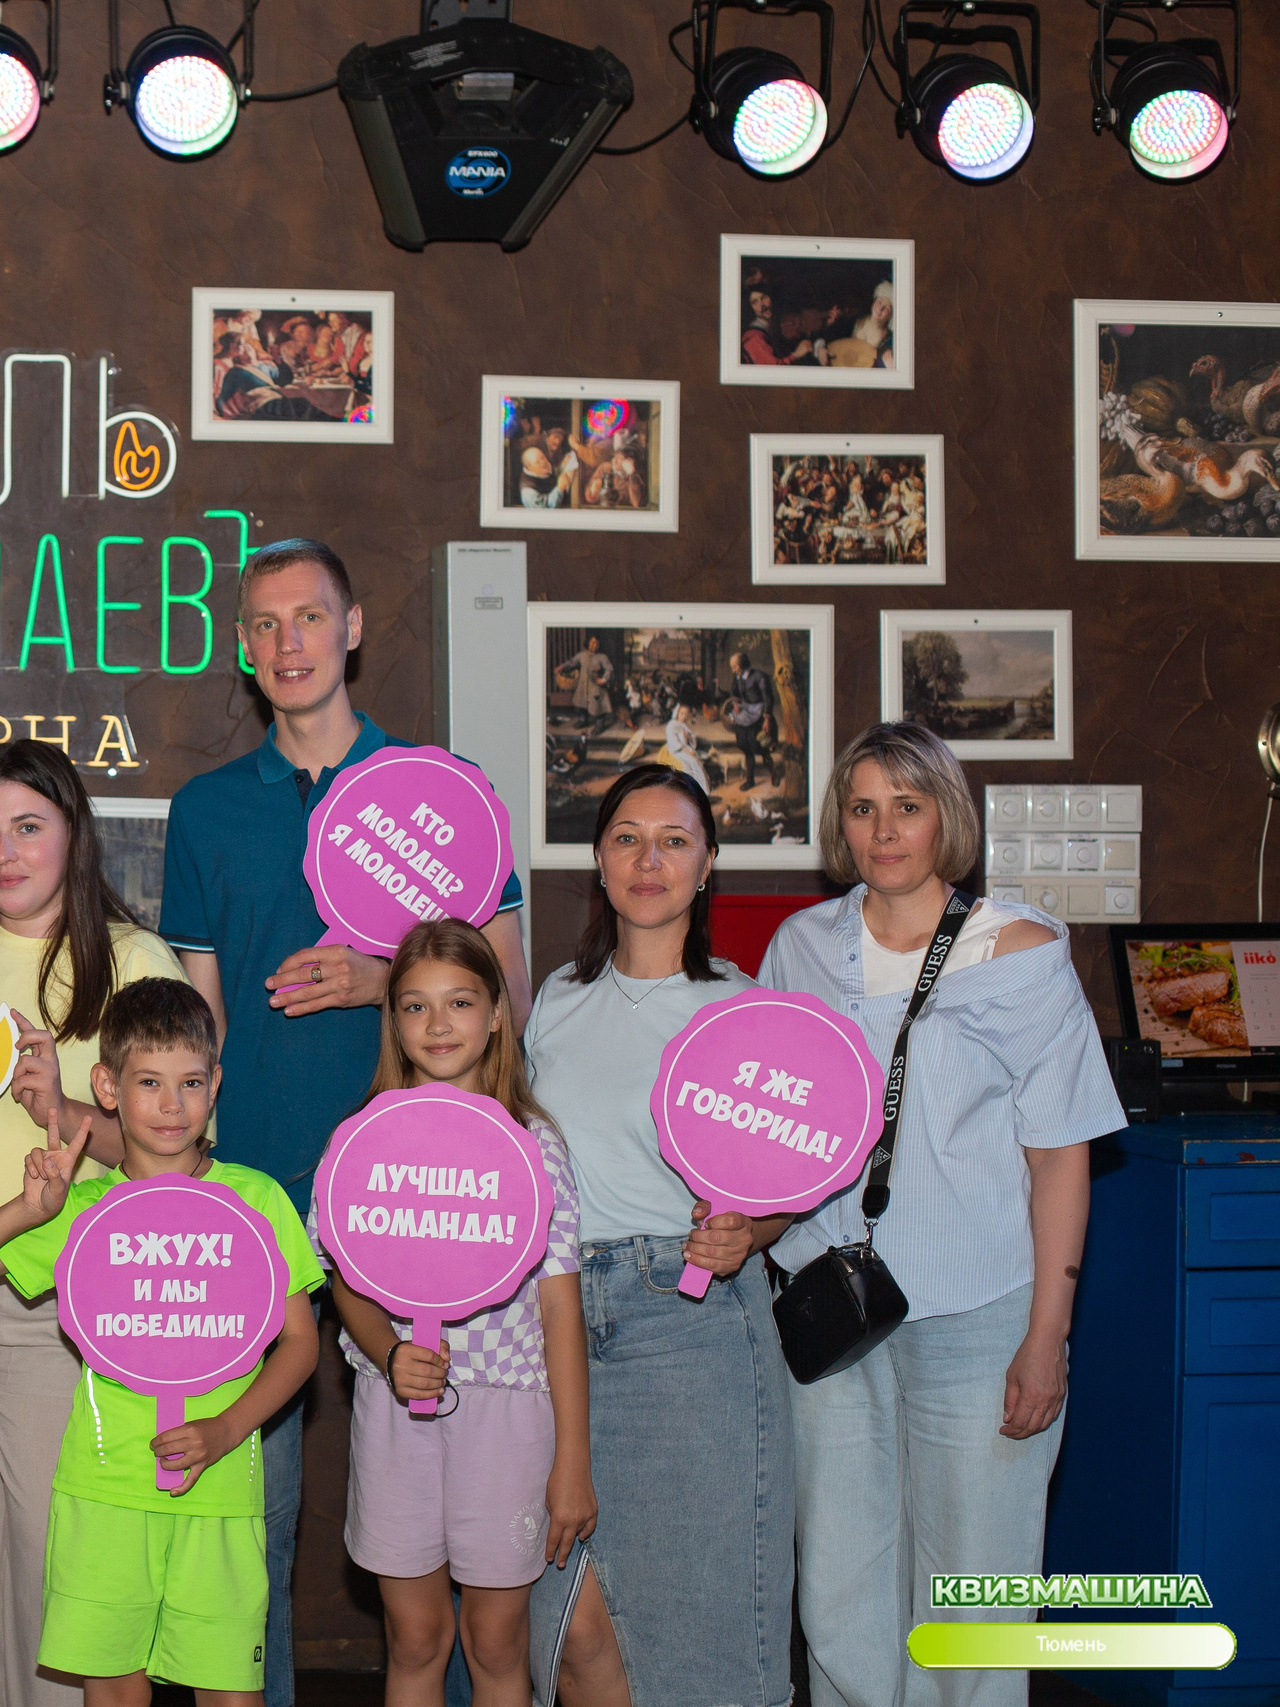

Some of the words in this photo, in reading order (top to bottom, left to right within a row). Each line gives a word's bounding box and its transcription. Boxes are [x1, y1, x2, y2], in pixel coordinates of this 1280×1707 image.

[449, 166, 506, 178] MANIA
[327, 824, 353, 847] Я
[410, 802, 455, 846] КТО
[356, 802, 464, 899] МОЛОДЕЦ?
[917, 934, 952, 992] GUESS
[732, 1061, 761, 1088] Я
[760, 1069, 813, 1107] ЖЕ
[884, 1055, 904, 1121] GUESS
[676, 1081, 842, 1163] ГОВОРИЛА!
[367, 1163, 500, 1200] ЛУЧШАЯ
[347, 1205, 516, 1245] КОМАНДА!
[109, 1231, 233, 1267] ВЖУХ!
[134, 1279, 152, 1301] И
[159, 1279, 207, 1303] МЫ
[96, 1313, 245, 1339] ПОБЕДИЛИ!
